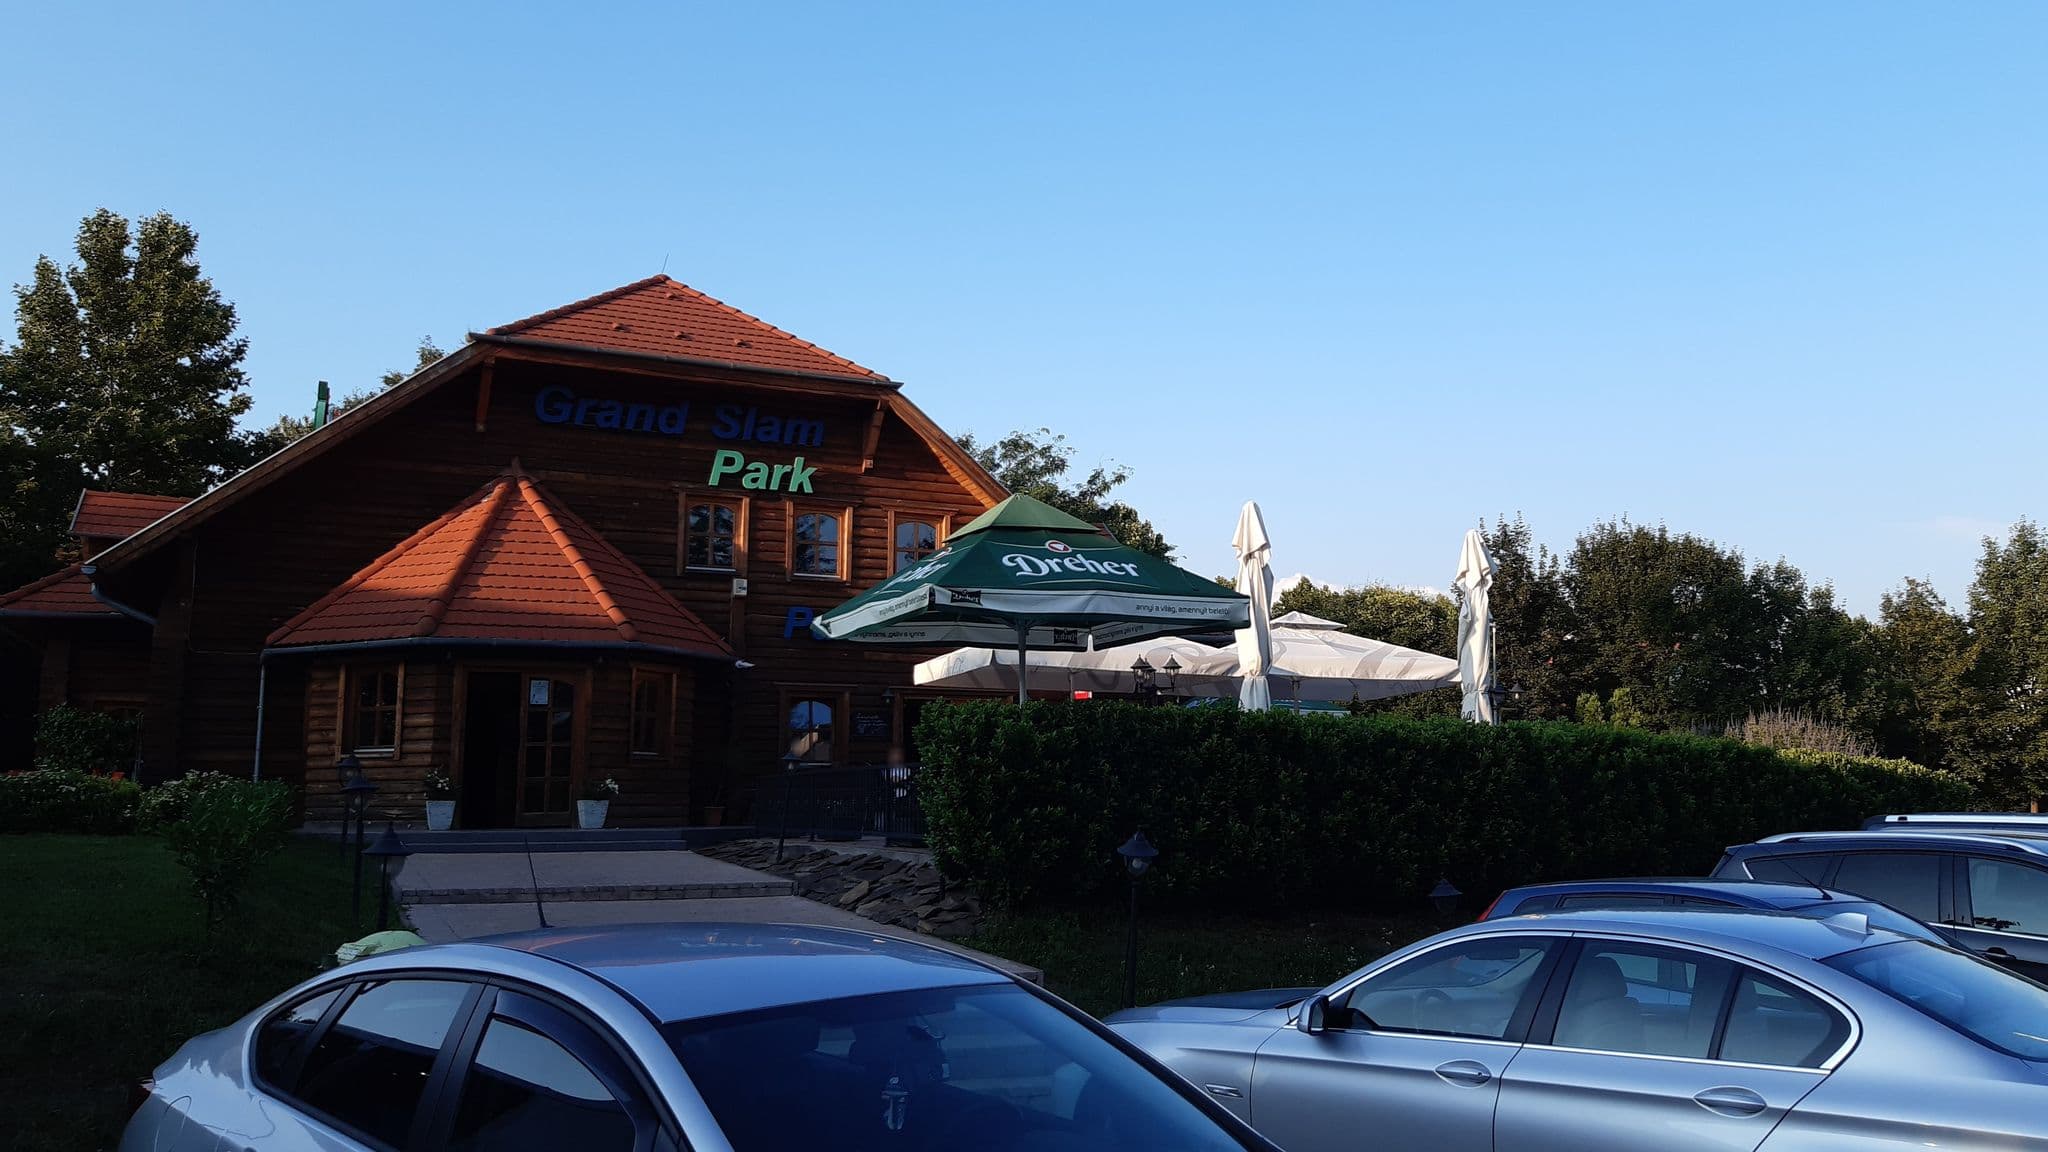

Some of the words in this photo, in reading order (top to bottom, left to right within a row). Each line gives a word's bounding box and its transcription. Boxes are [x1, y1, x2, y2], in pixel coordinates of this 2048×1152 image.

[535, 384, 690, 436] Grand
[710, 404, 826, 448] Slam
[708, 448, 818, 494] Park
[1002, 552, 1140, 577] Dreher
